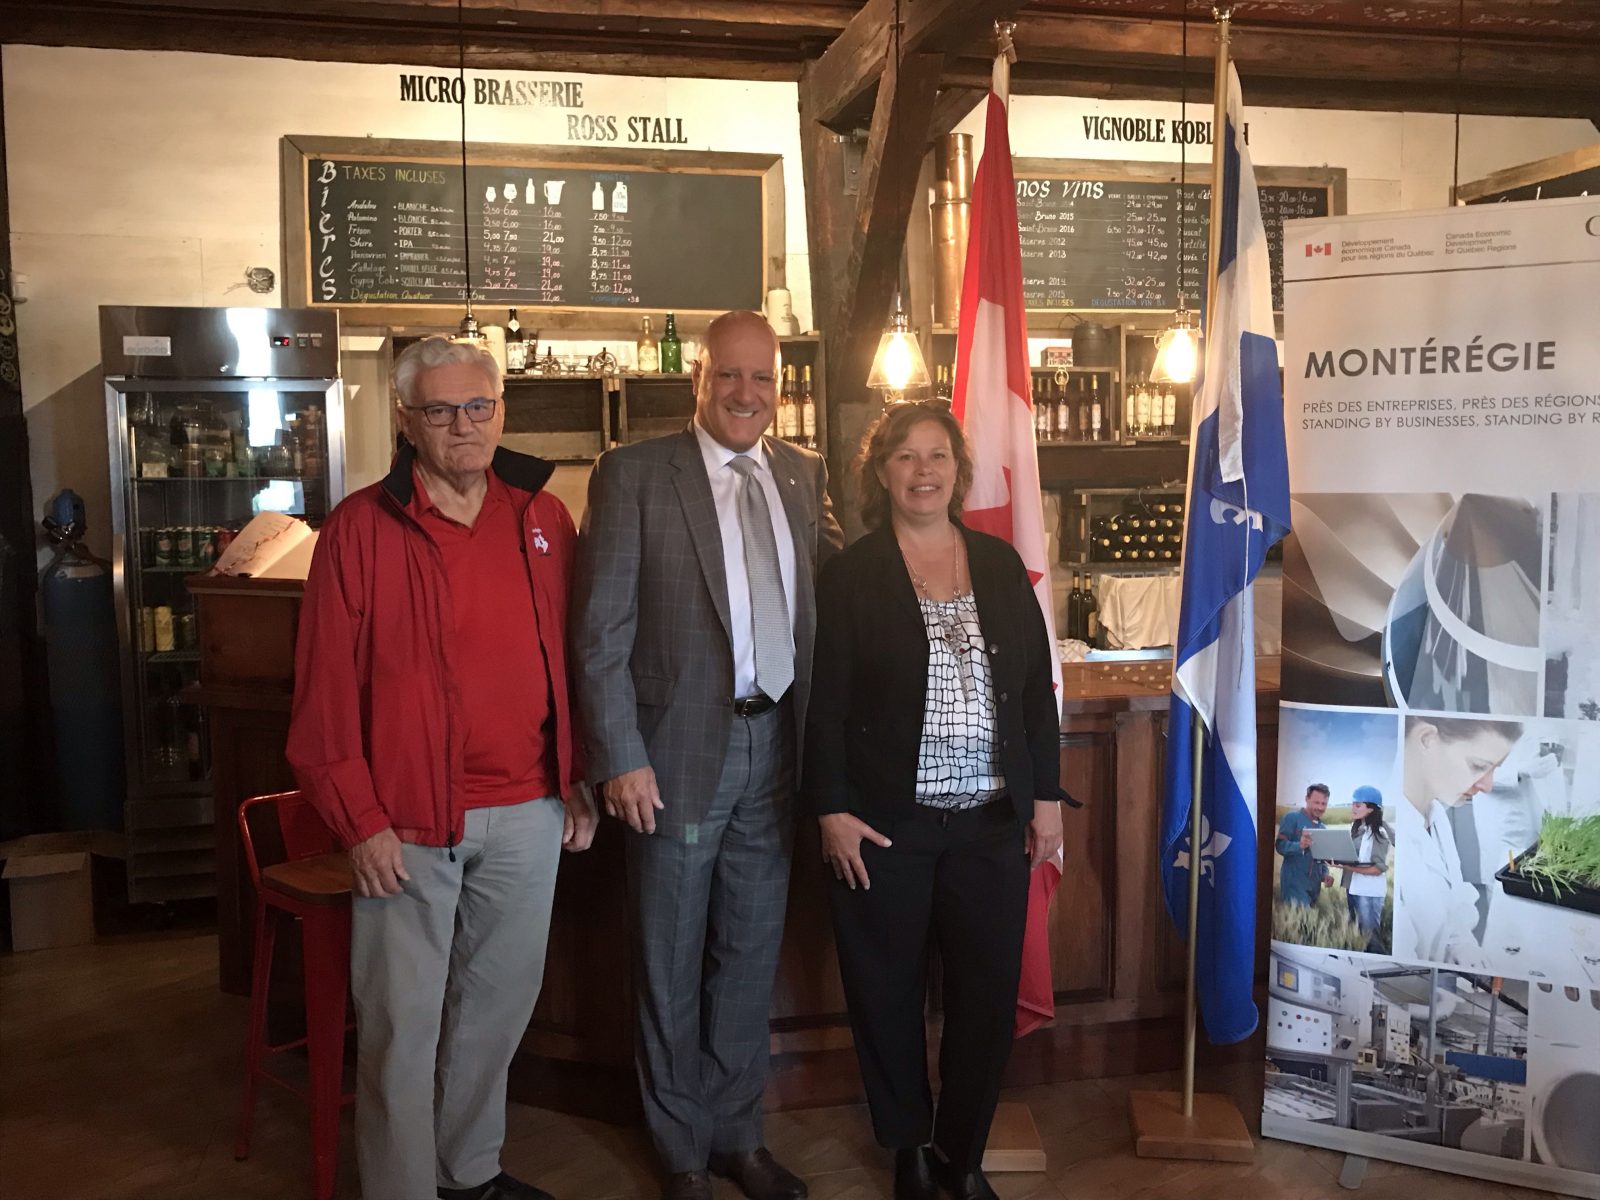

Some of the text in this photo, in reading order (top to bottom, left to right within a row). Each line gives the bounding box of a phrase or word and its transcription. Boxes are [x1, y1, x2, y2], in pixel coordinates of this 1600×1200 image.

[399, 74, 584, 108] MICRO BRASSERIE
[566, 113, 688, 144] ROSS STALL
[1083, 115, 1250, 146] VIGNOBLE KOBL
[342, 165, 446, 184] TAXES INCLUSES
[1017, 180, 1104, 199] nos vins
[398, 215, 427, 224] BLONDE
[398, 227, 423, 236] PORTER
[483, 229, 501, 241] 5,00
[542, 231, 565, 244] 21,00
[1059, 225, 1075, 233] 2016
[1445, 229, 1512, 240] Canada Economic
[399, 239, 414, 248] IPA
[1384, 243, 1411, 252] Canada
[1445, 237, 1493, 248] Development
[1445, 247, 1455, 255] for
[1487, 243, 1517, 253] Regions
[1048, 250, 1067, 259] 2013
[1341, 255, 1357, 264] pour
[1304, 336, 1556, 379] MONTÉRÉGIE
[1302, 400, 1333, 414] PRÈS
[1337, 401, 1362, 413] DES
[1462, 395, 1496, 410] PRÈS
[1501, 396, 1529, 409] DES
[1302, 416, 1371, 430] STANDING
[1375, 416, 1392, 429] BY
[1484, 412, 1563, 427] STANDING
[1567, 411, 1586, 424] BY
